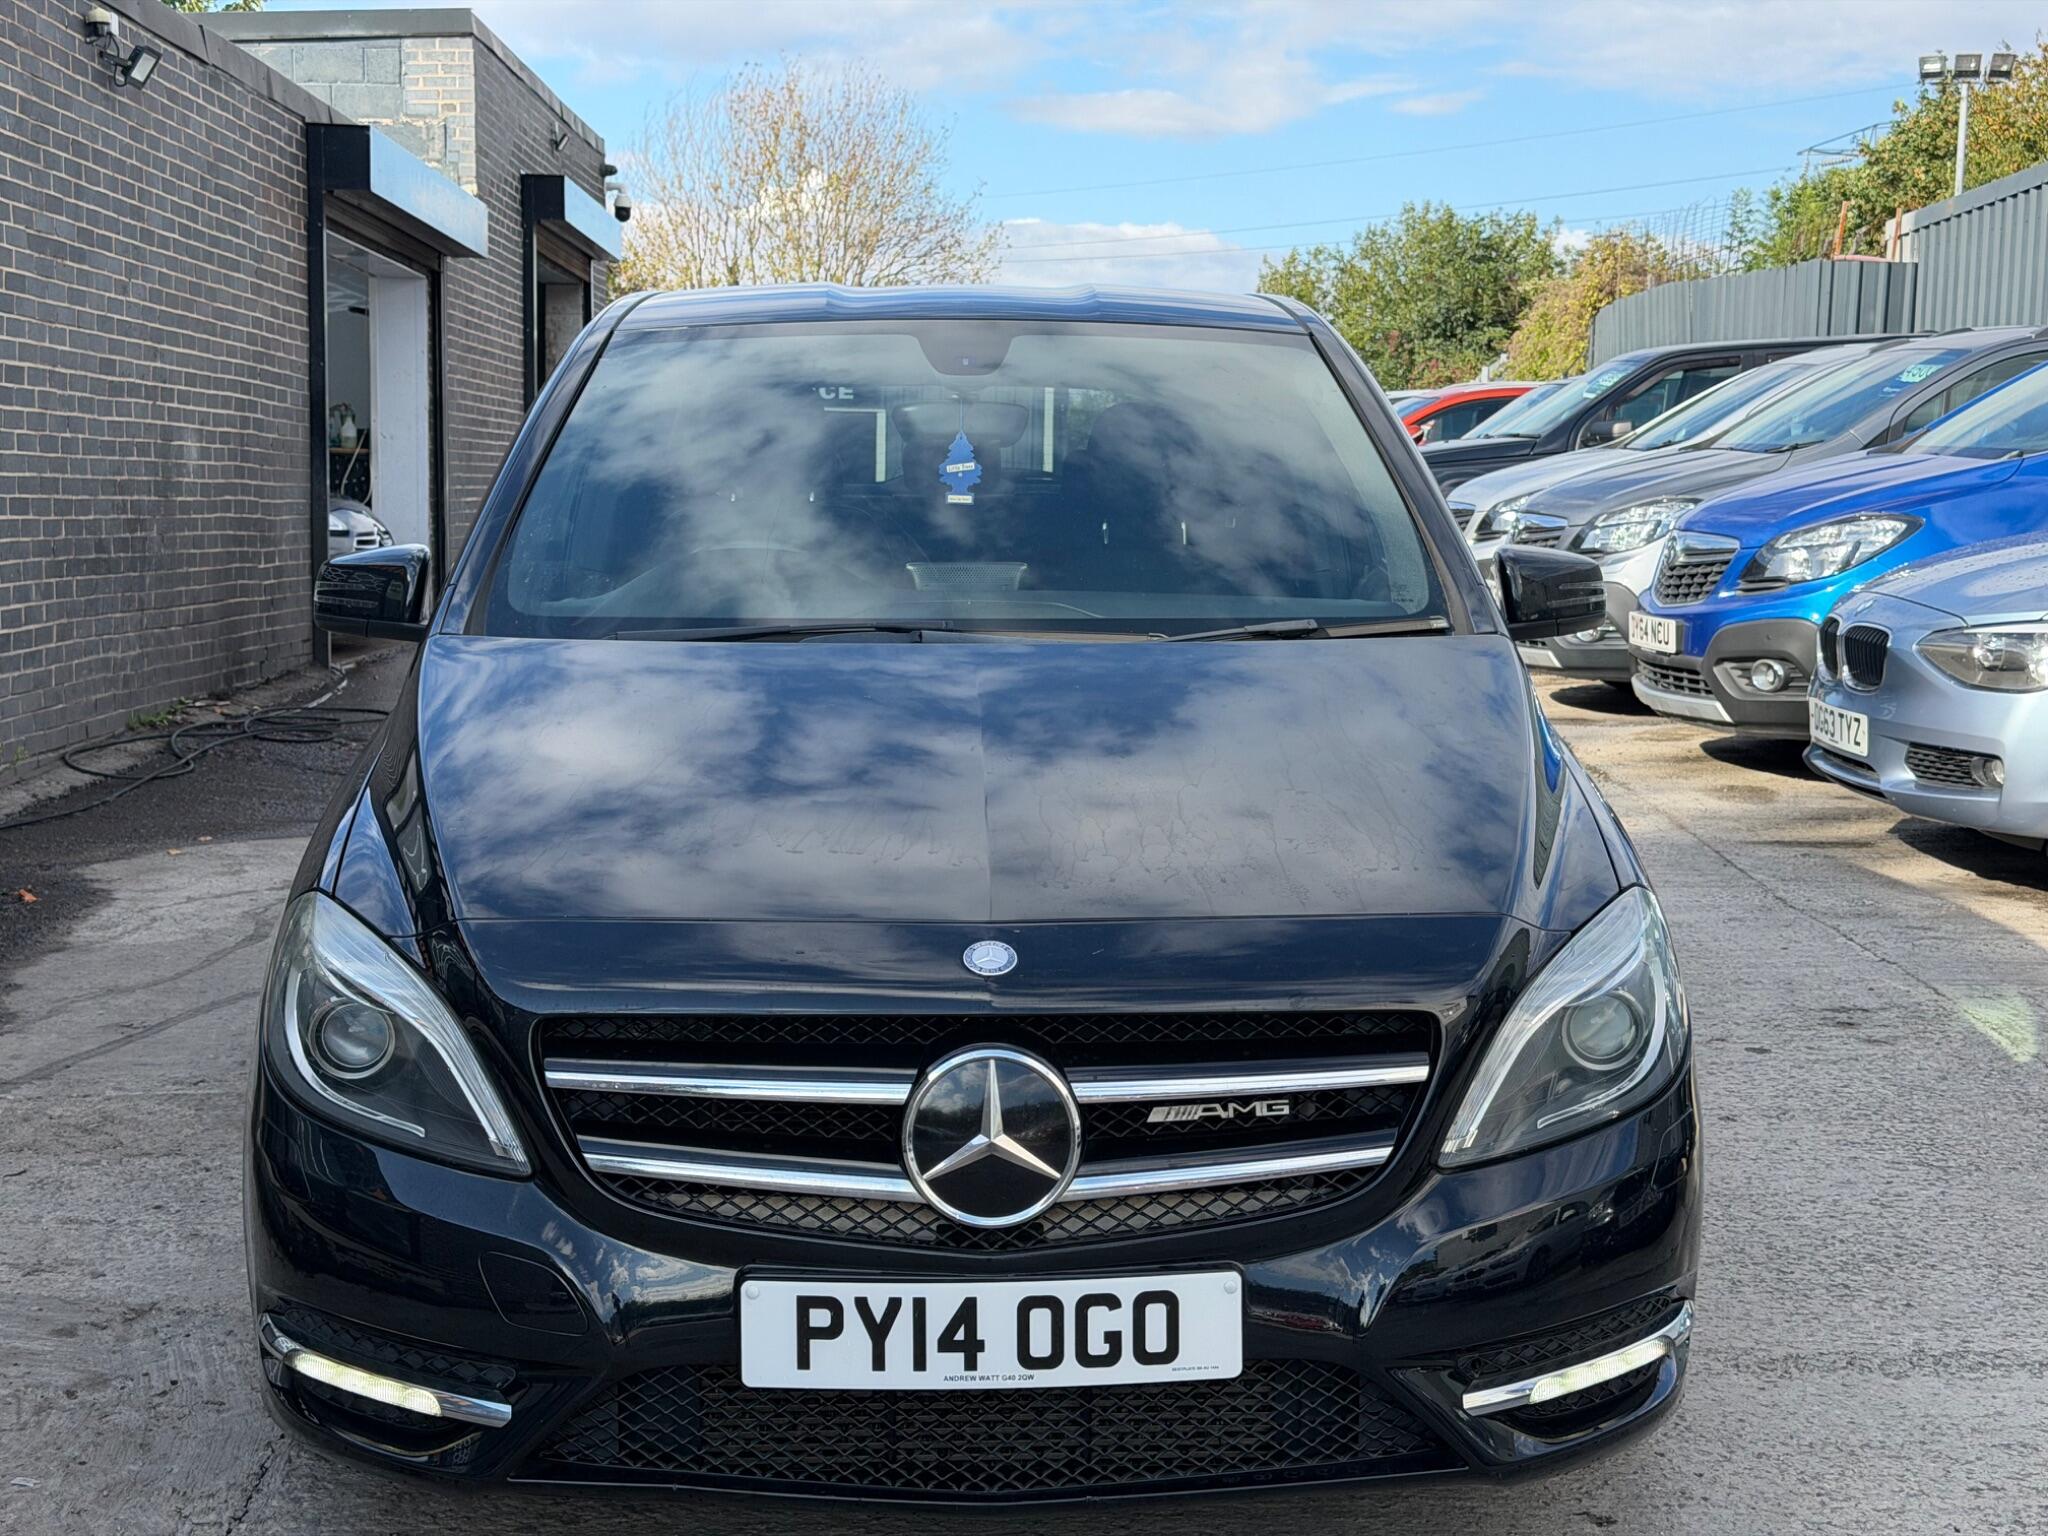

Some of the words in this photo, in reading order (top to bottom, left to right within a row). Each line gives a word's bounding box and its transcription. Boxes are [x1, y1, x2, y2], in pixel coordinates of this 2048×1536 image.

[1837, 711, 1861, 747] TYZ
[1194, 1099, 1290, 1120] AMG
[796, 1295, 985, 1372] PY14
[1016, 1289, 1180, 1371] OGO
[943, 1374, 977, 1382] ANDREW
[978, 1374, 1001, 1382] WATT
[1001, 1373, 1017, 1381] G40
[1017, 1373, 1035, 1381] 2QW
